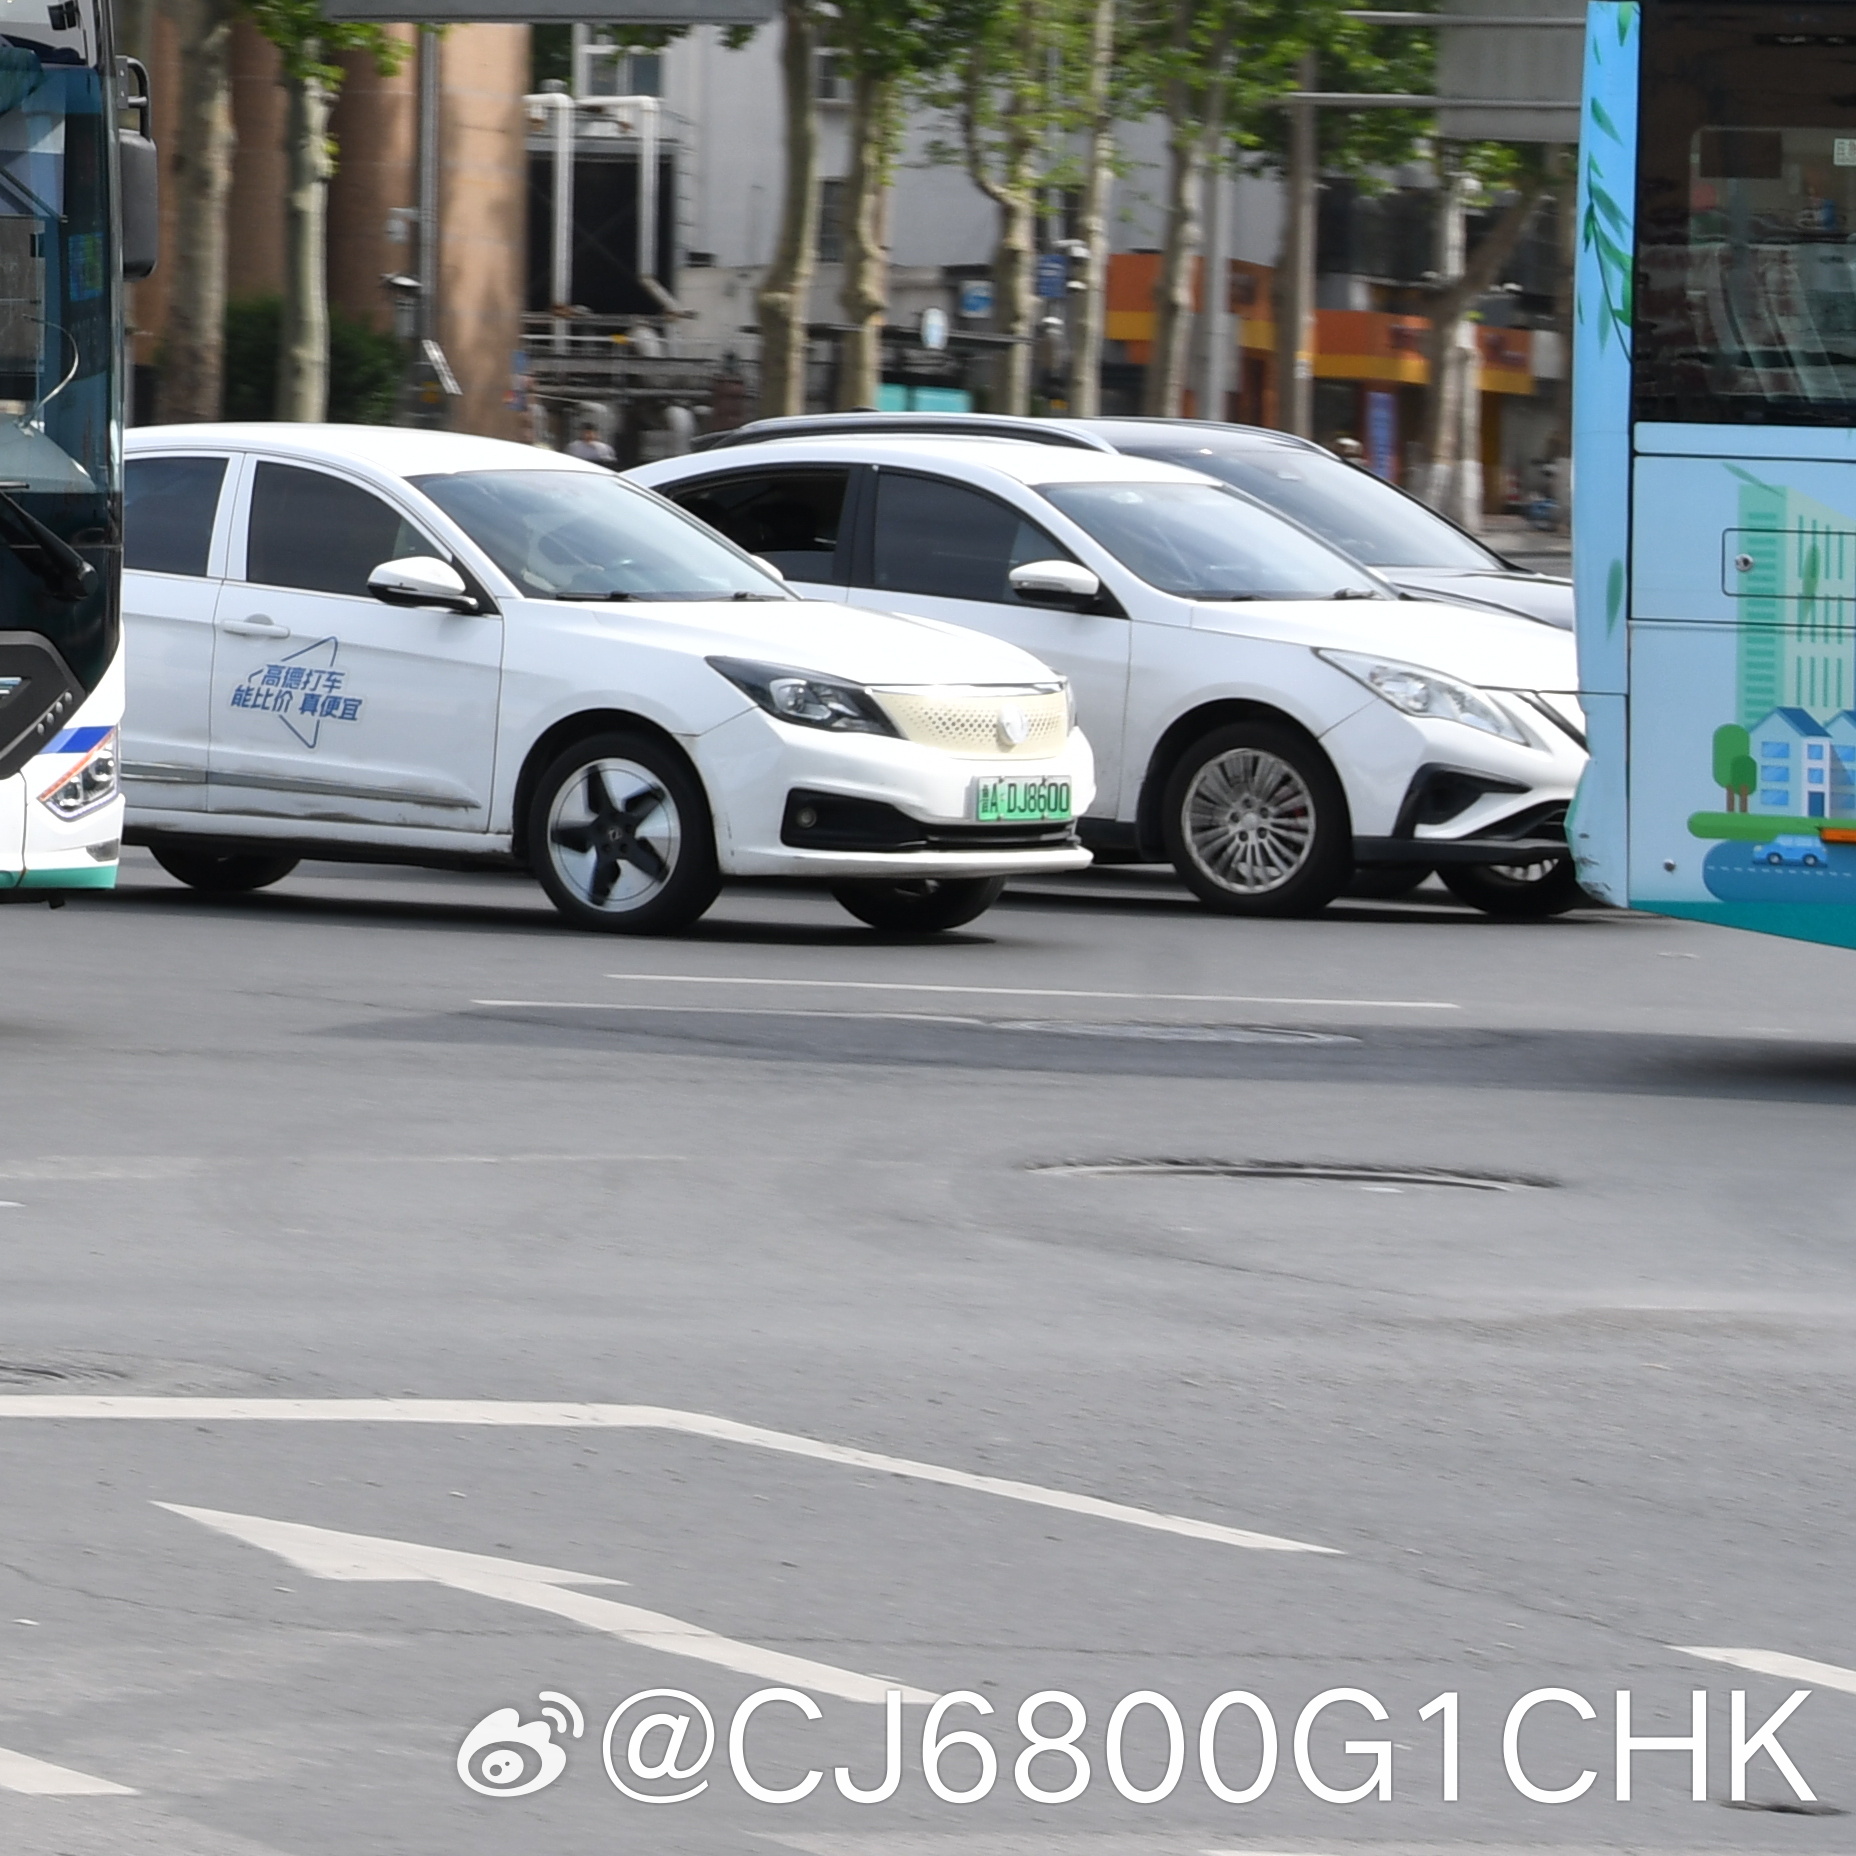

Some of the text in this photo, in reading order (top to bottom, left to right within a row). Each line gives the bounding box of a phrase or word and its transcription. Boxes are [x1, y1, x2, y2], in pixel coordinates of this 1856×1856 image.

[261, 663, 345, 693] 高德打车
[230, 684, 363, 721] 能比价 真便宜
